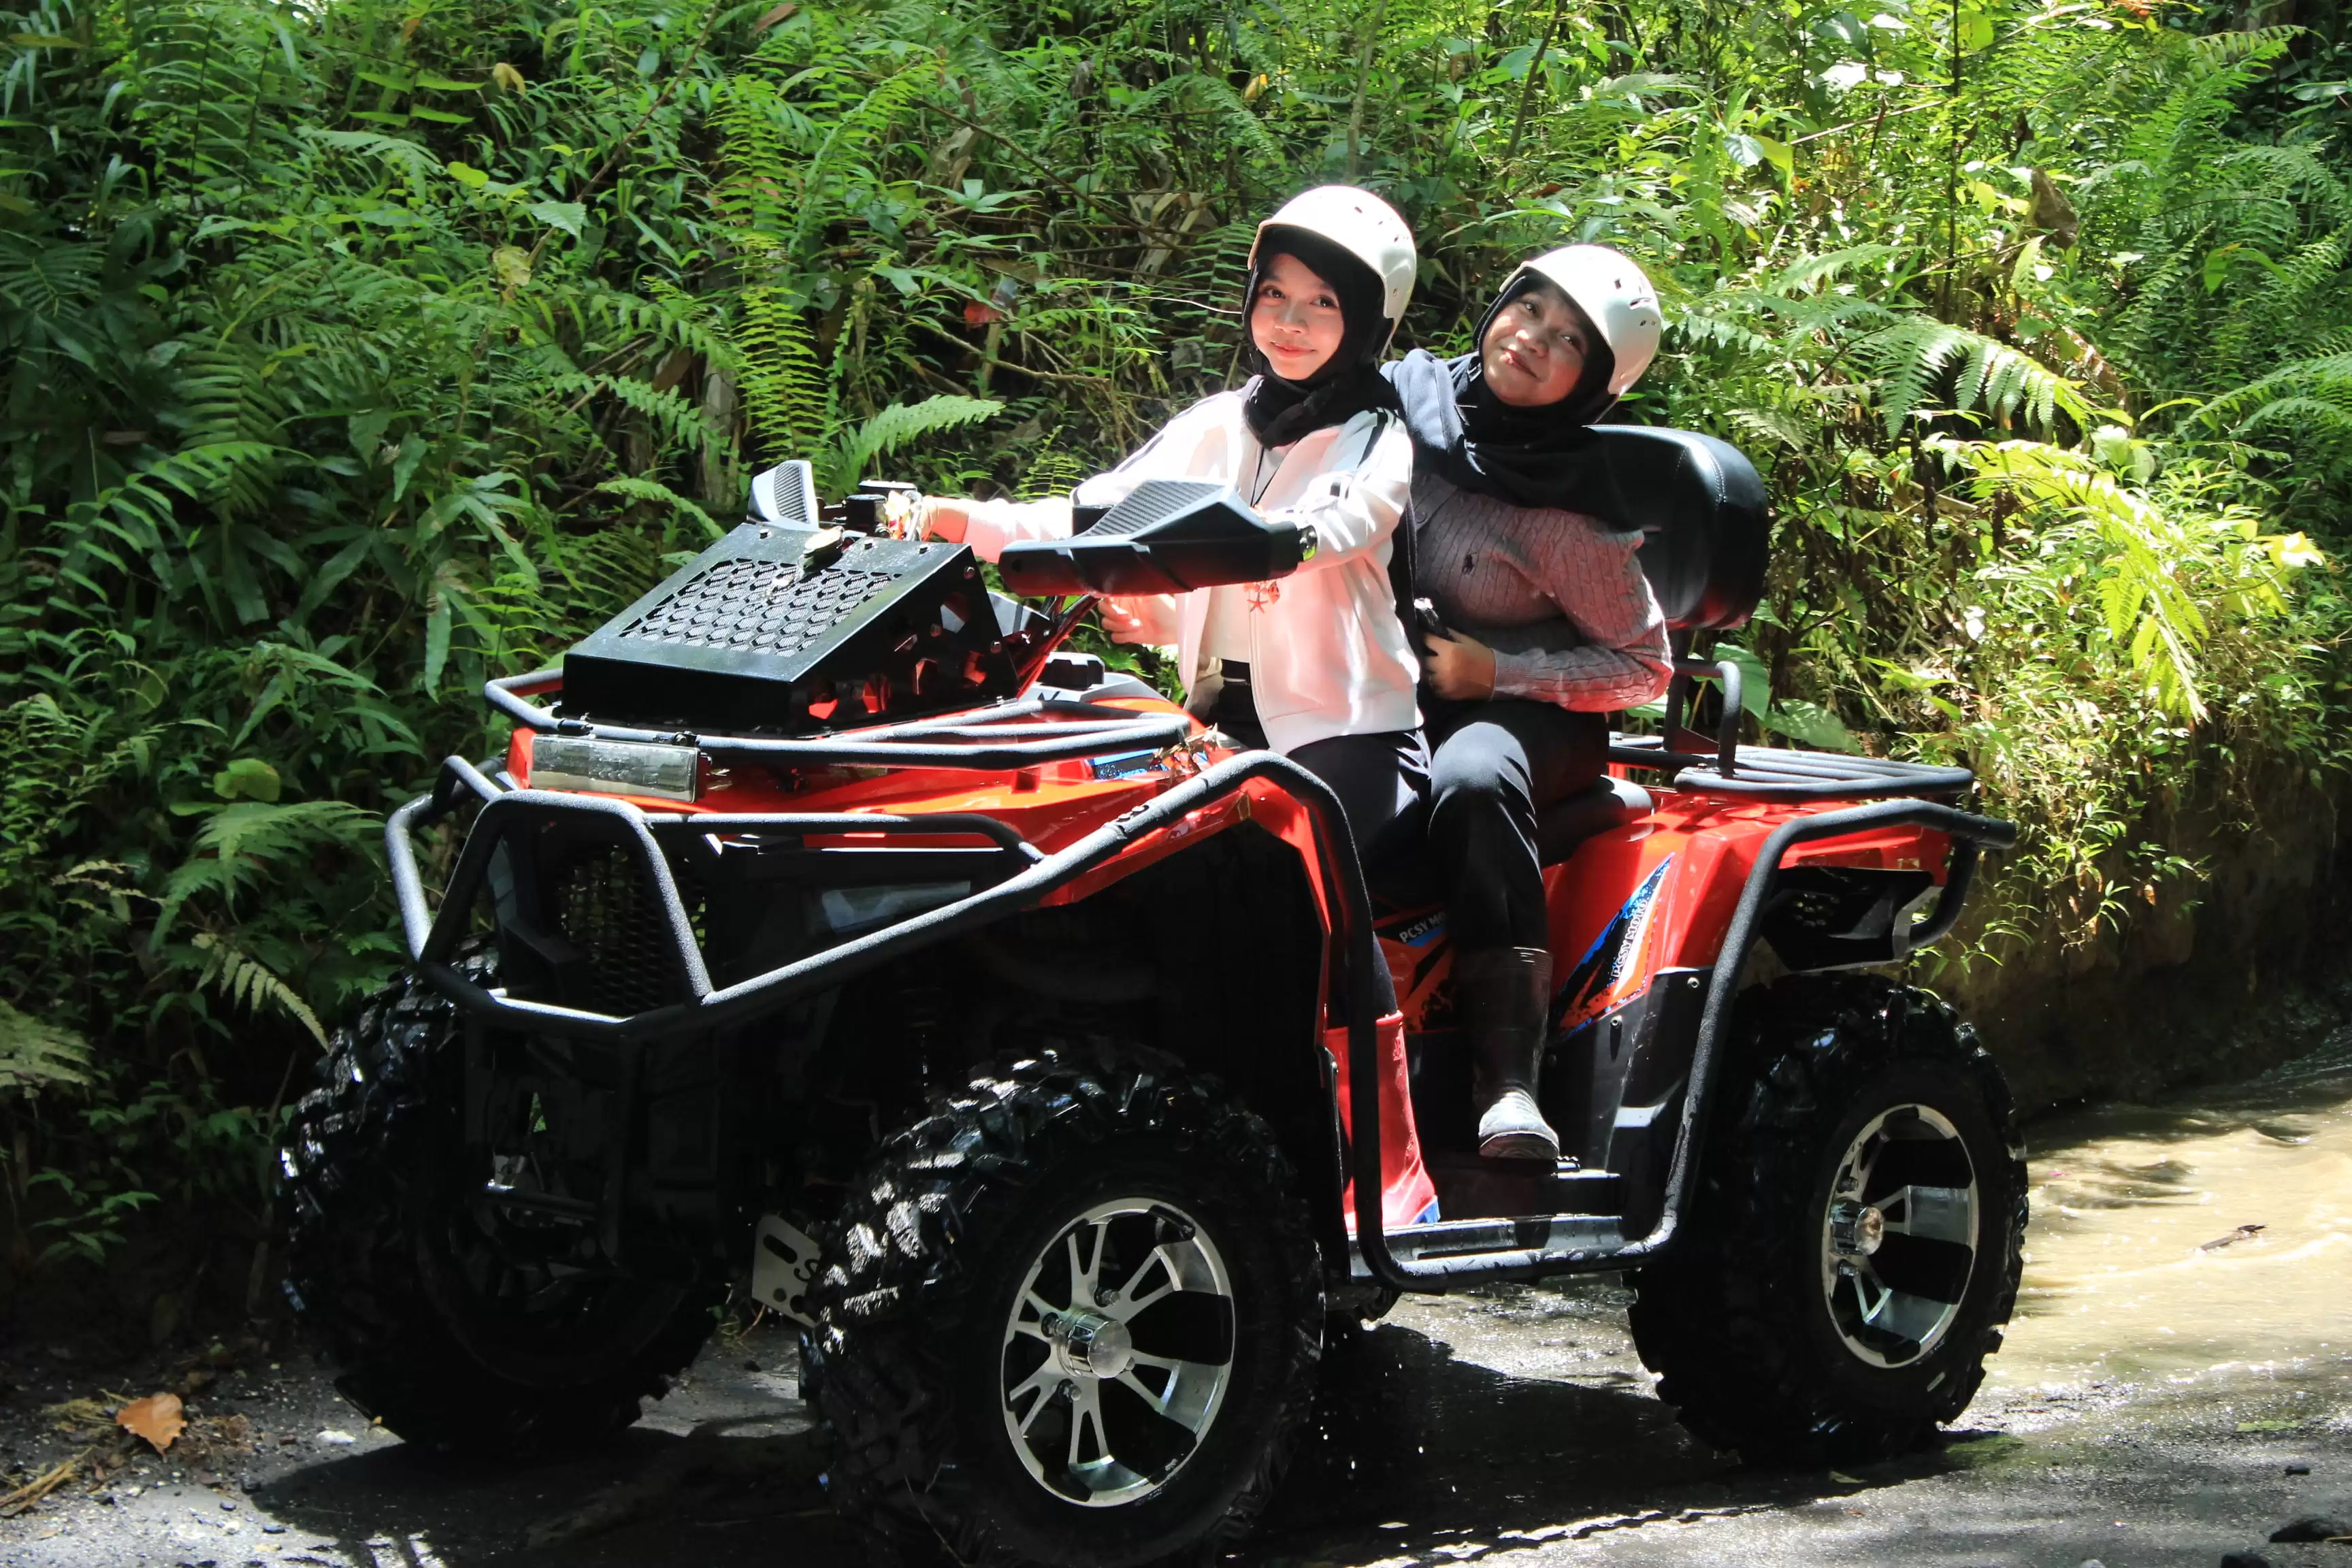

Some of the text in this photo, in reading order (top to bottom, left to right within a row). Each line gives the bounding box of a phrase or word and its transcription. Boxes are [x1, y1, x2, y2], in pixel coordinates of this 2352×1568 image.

[1399, 912, 1446, 943] PCSY MO
[1611, 900, 1647, 977] PCSY MOTO
